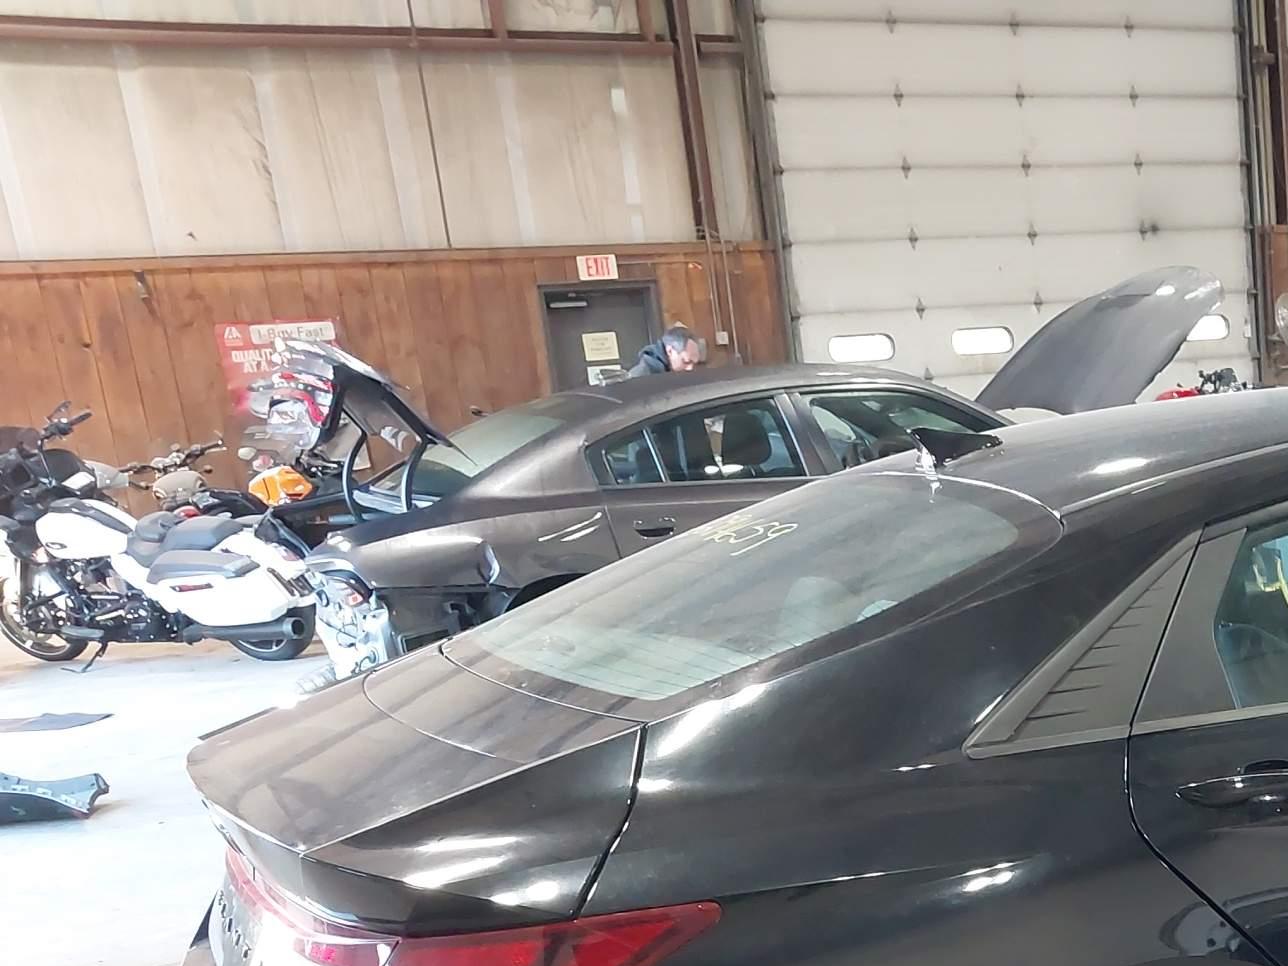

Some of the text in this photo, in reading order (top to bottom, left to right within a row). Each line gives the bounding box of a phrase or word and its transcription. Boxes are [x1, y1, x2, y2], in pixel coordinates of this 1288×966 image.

[585, 256, 611, 277] EXIT
[296, 325, 326, 338] Fast
[231, 348, 274, 363] QUALIT
